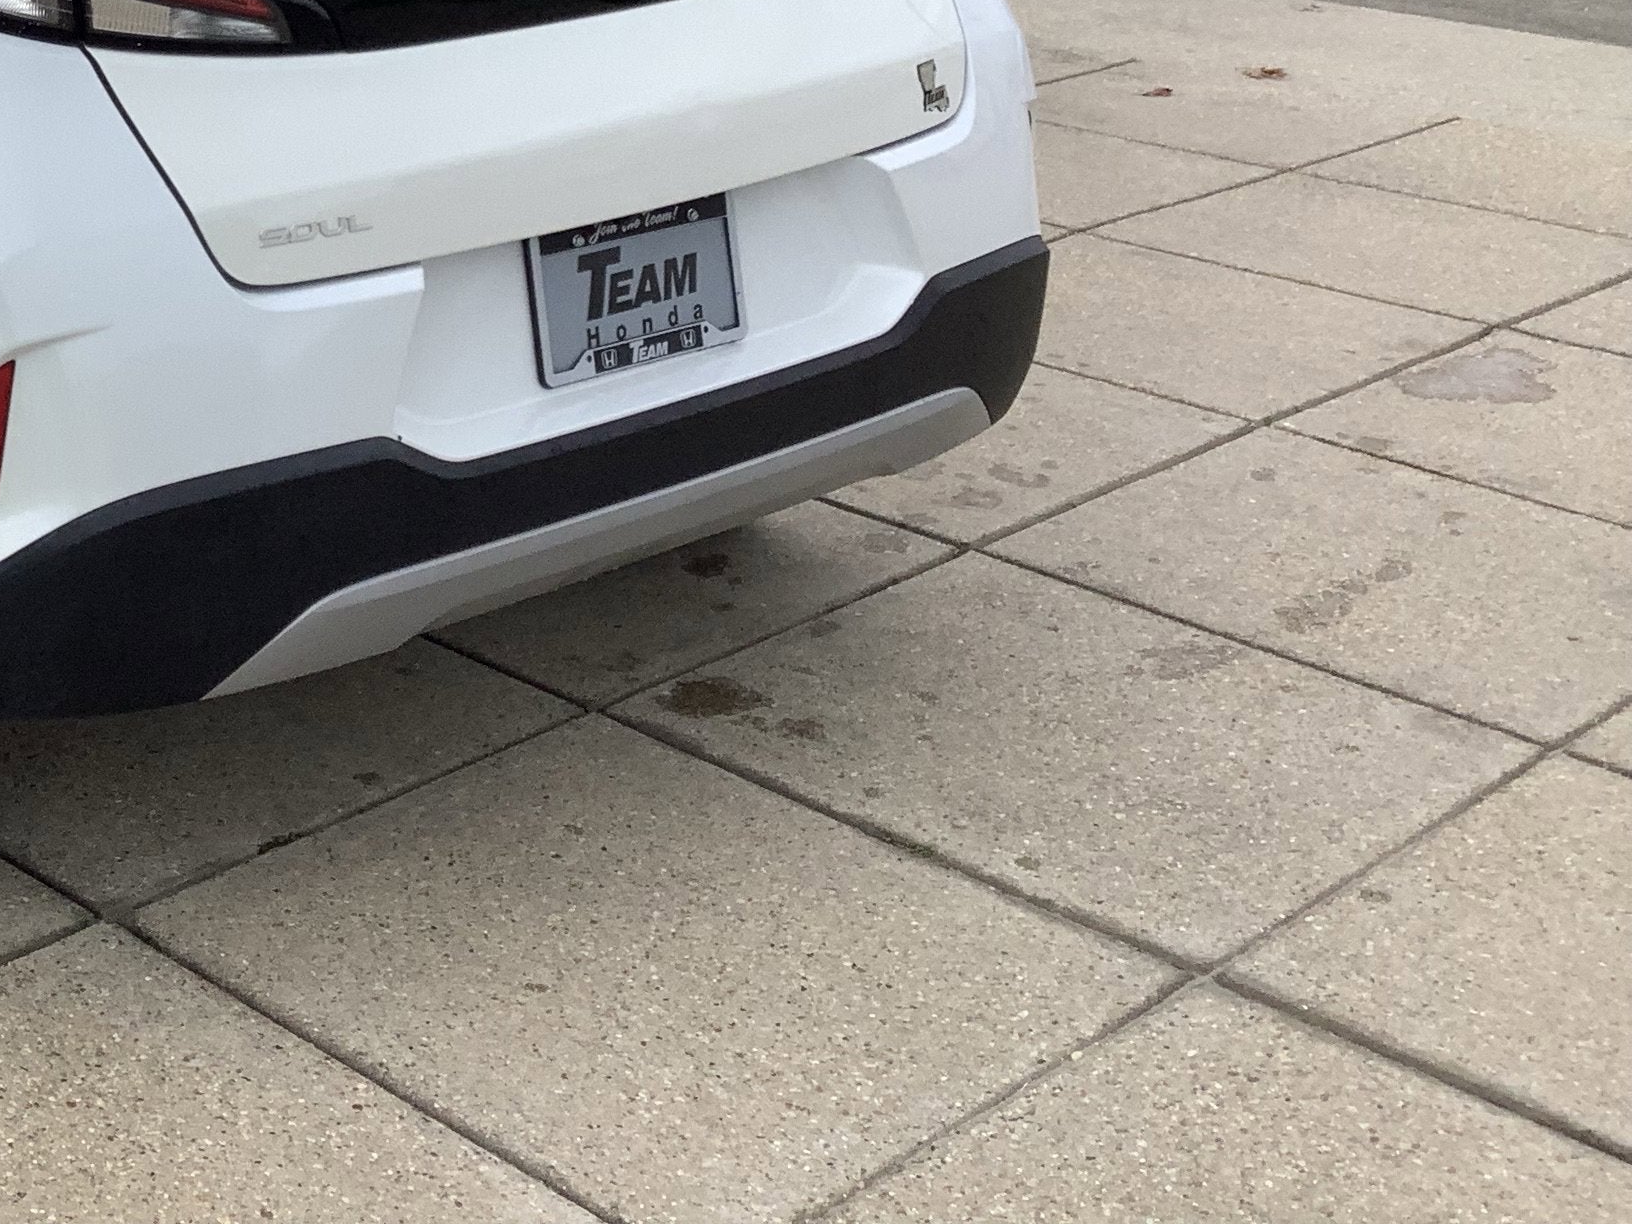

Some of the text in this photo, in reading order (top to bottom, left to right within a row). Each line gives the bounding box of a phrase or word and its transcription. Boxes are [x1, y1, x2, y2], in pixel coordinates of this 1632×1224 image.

[258, 215, 373, 249] SOUL
[589, 221, 618, 245] Join
[576, 246, 698, 322] TEAM
[586, 303, 704, 349] Honda
[629, 339, 669, 364] TEAM
